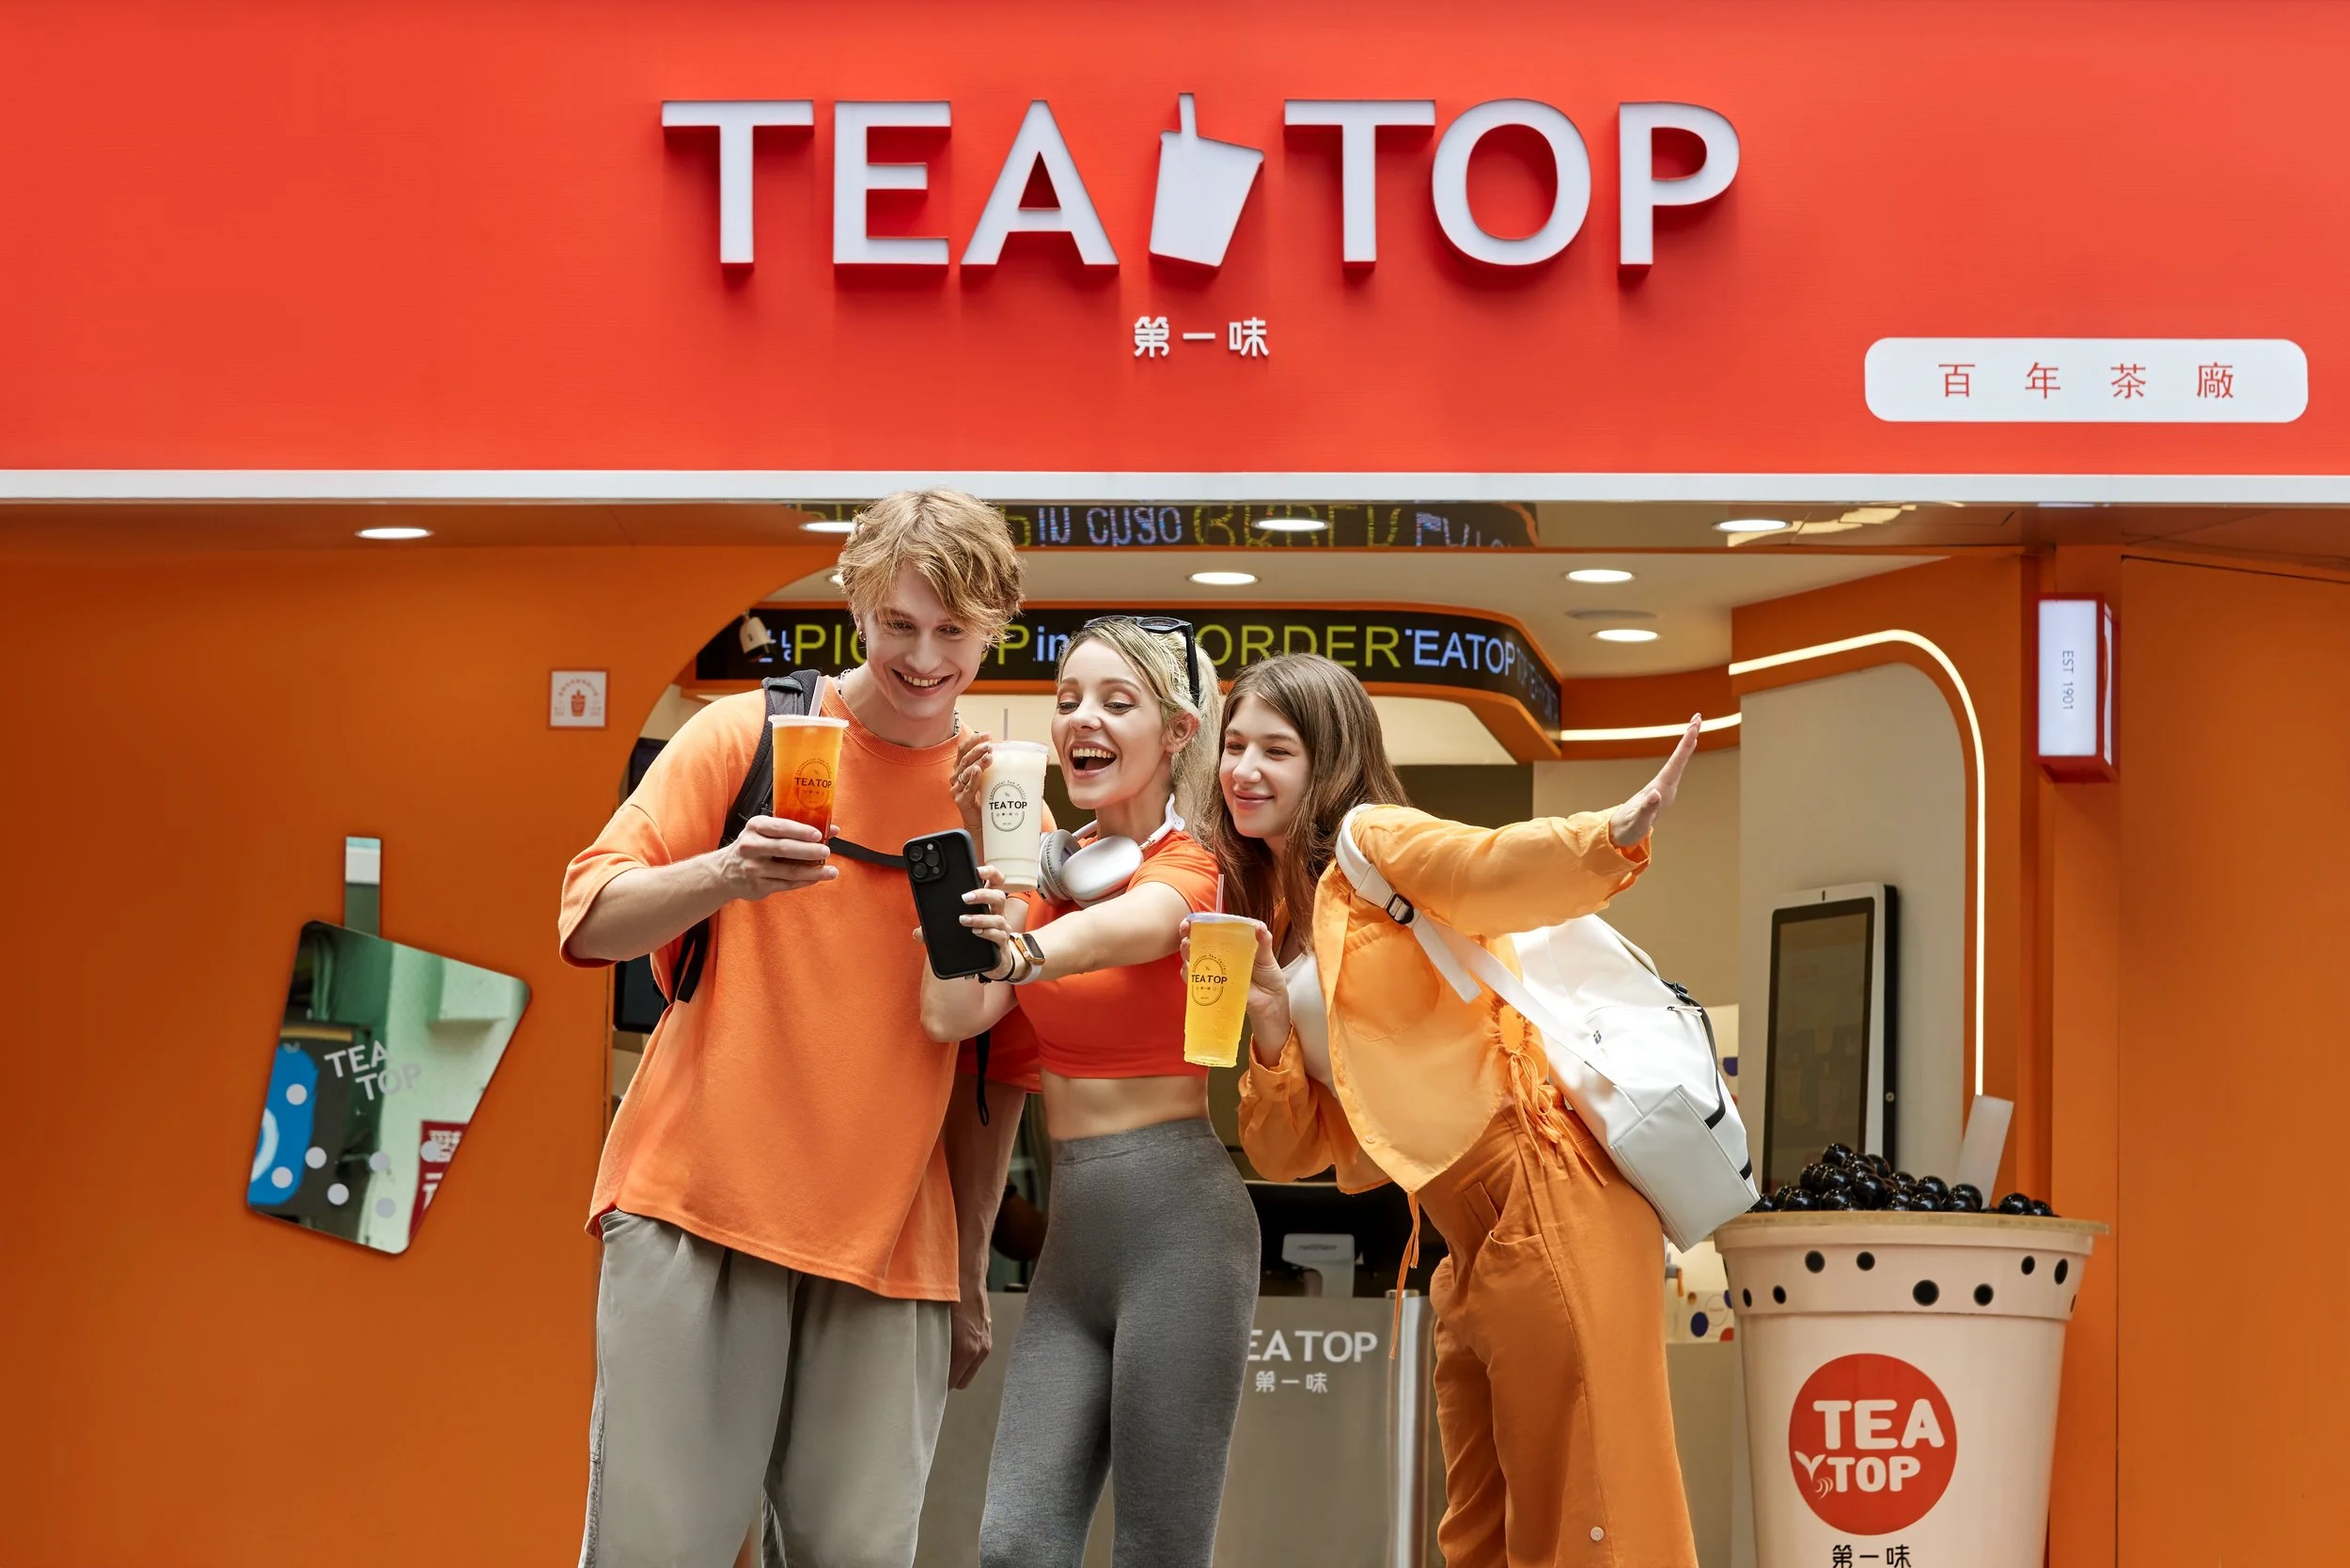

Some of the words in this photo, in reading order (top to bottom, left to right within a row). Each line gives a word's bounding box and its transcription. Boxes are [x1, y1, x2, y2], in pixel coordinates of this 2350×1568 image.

[661, 100, 1120, 268] TEA
[1284, 98, 1742, 268] TOP
[1134, 316, 1269, 358] 第一味
[1938, 362, 2234, 400] 百年茶廠
[794, 624, 867, 665] PIC
[1196, 624, 1401, 668] ORDER
[1404, 628, 1516, 676] EATOP
[2062, 651, 2074, 673] EST
[2062, 682, 2074, 710] 1901
[989, 801, 1027, 810] TEATOP
[323, 1040, 391, 1078] TEA
[355, 1062, 421, 1101] TOP
[1247, 1329, 1378, 1363] EATOP
[1255, 1371, 1328, 1393] 第一味
[1812, 1398, 1946, 1450] TEA
[1826, 1456, 1921, 1493] TOP
[1832, 1544, 1912, 1568] 第一味
